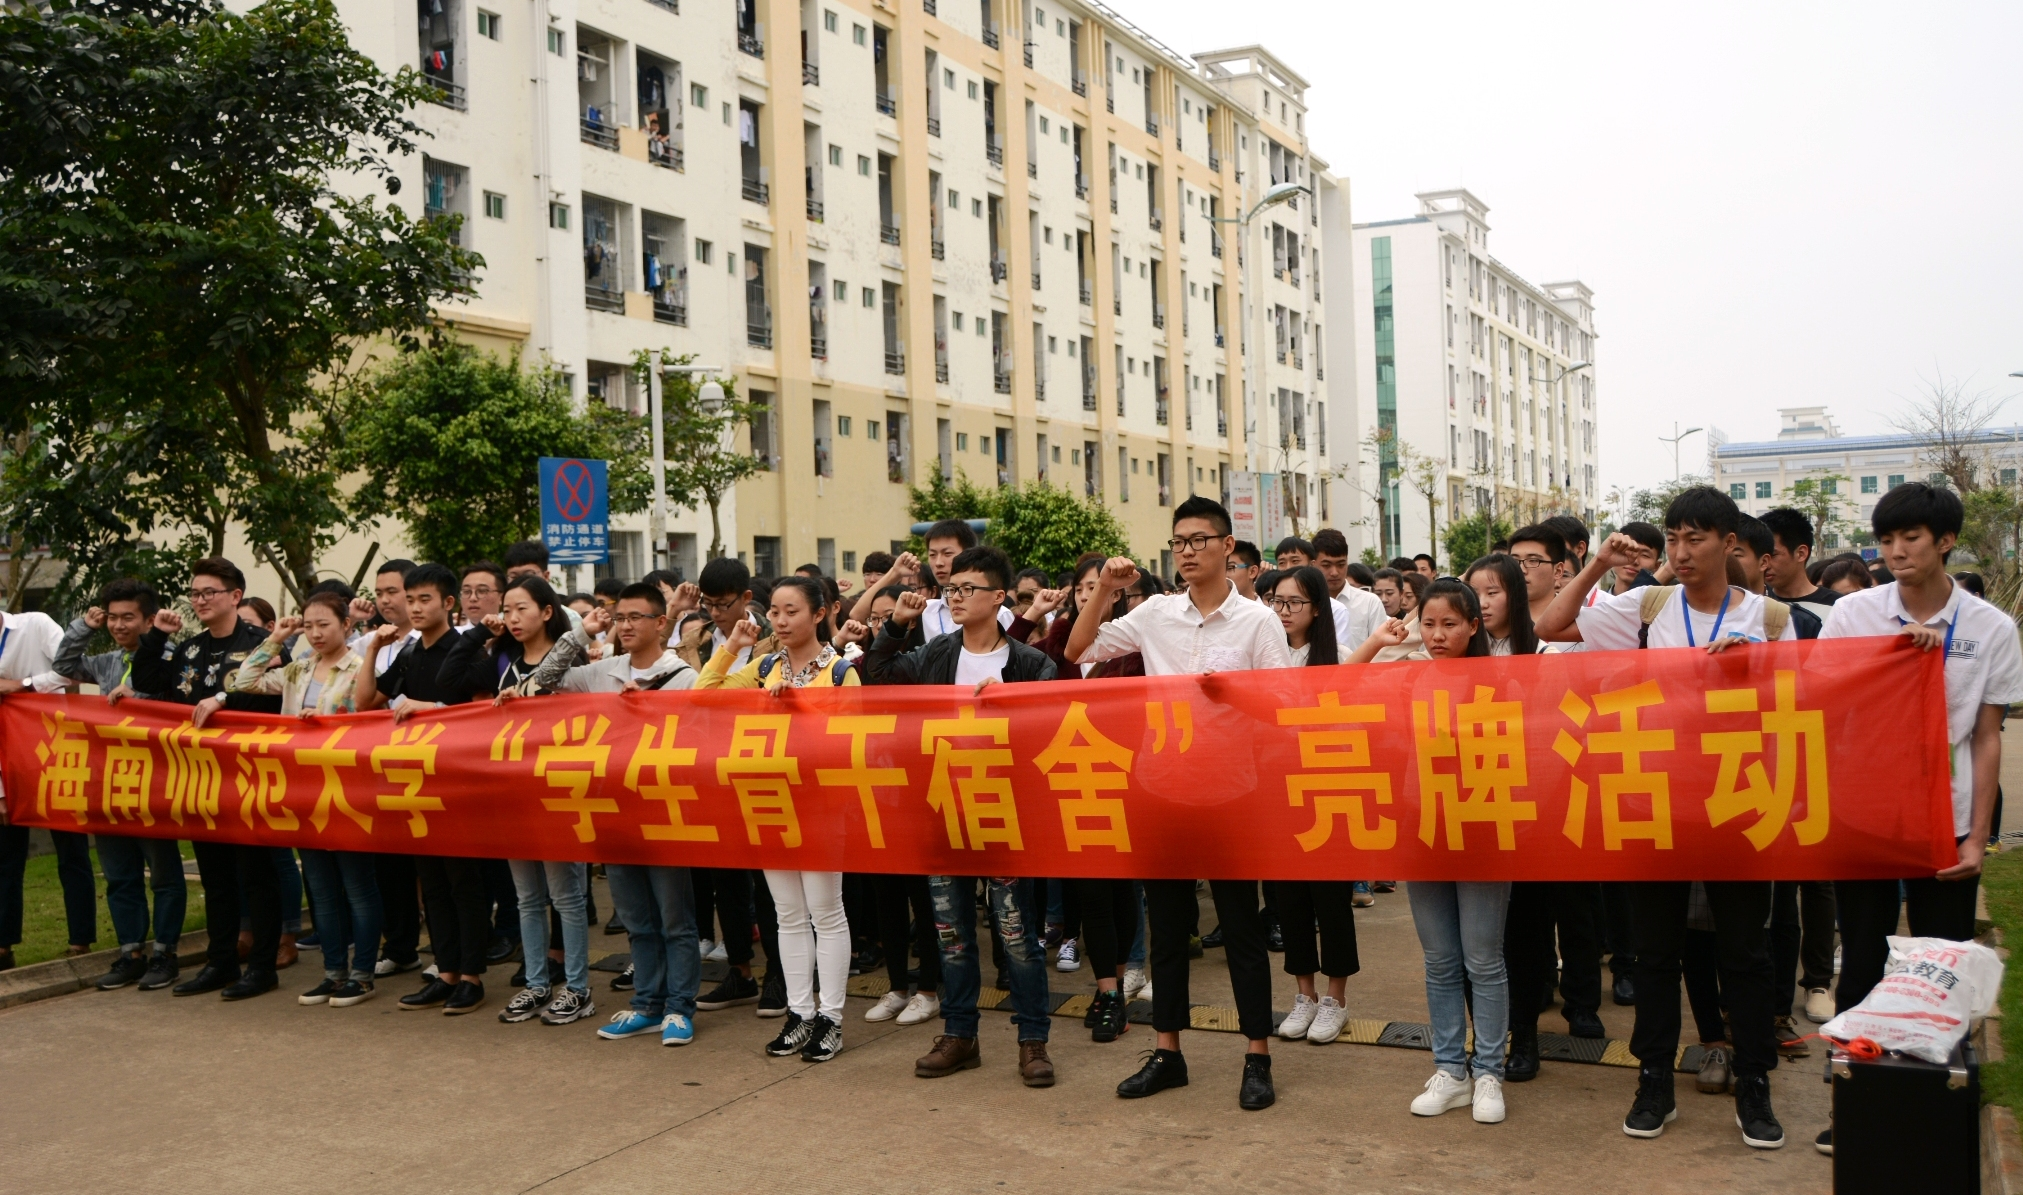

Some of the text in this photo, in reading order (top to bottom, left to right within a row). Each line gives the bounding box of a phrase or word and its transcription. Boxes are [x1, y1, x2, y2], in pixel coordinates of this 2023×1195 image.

[546, 524, 604, 535] 消防通道
[548, 536, 605, 547] 禁止停车
[1963, 641, 1976, 653] DAY
[36, 710, 446, 839] 海南师范大学
[1277, 670, 1831, 852] 亮牌活动
